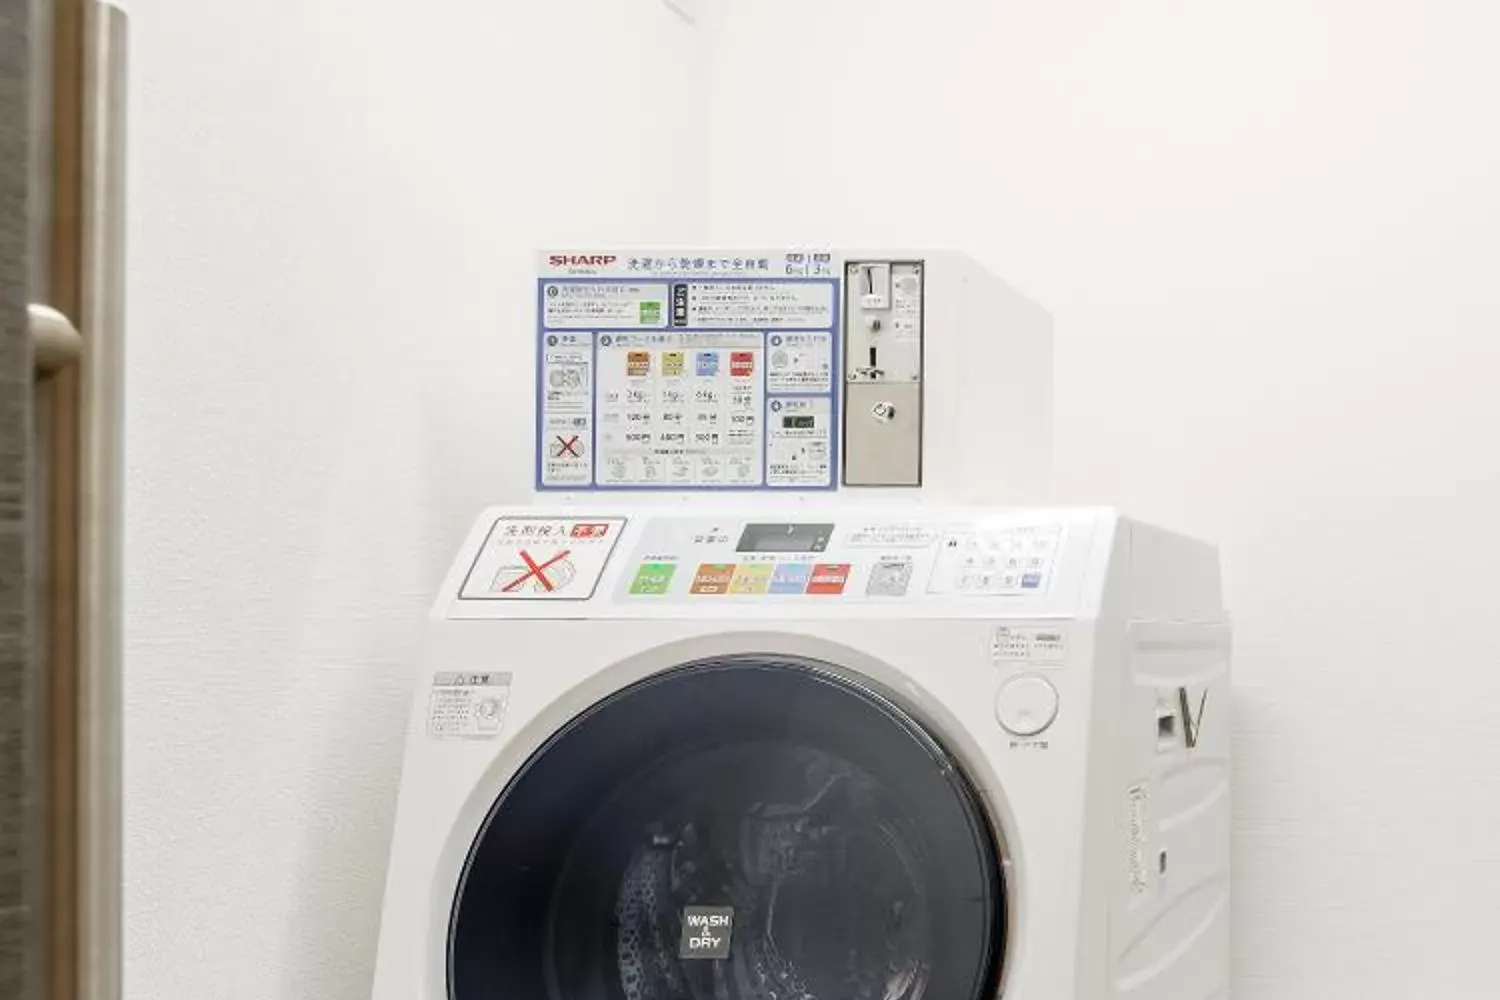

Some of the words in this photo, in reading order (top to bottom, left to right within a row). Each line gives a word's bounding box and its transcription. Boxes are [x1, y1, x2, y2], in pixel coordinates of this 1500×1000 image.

[549, 255, 617, 265] SHARP
[687, 915, 729, 927] WASH
[689, 937, 721, 949] DRY
